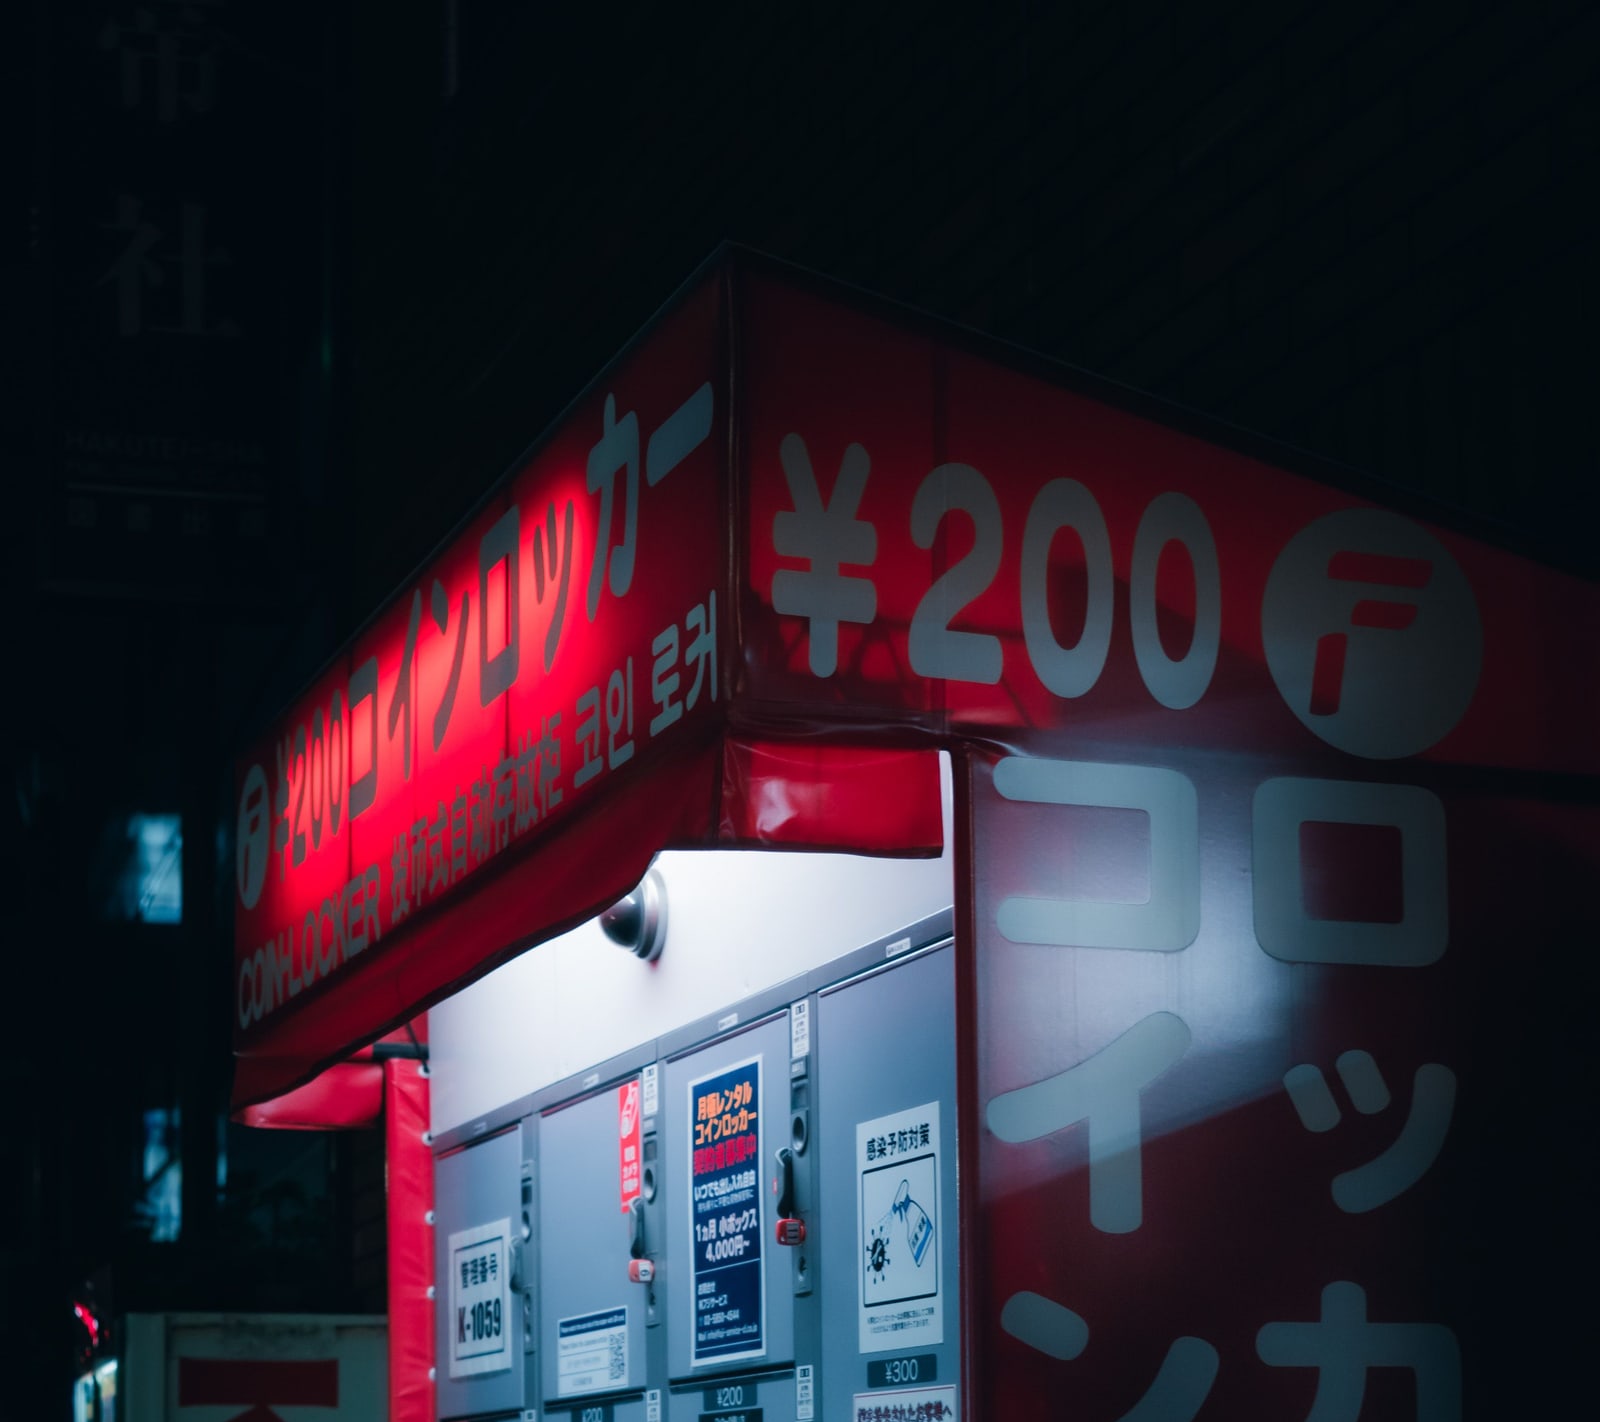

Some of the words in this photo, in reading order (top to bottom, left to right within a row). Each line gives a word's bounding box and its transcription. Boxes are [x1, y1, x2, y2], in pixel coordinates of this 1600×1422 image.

[771, 432, 1223, 711] ¥200
[573, 656, 635, 790] 코인
[649, 590, 717, 738] 로커
[695, 1107, 757, 1145] コインロッカー
[866, 1122, 930, 1161] 感染予防対策
[458, 1298, 501, 1344] K-1059
[885, 1359, 918, 1383] ¥300
[716, 1385, 743, 1407] ¥200
